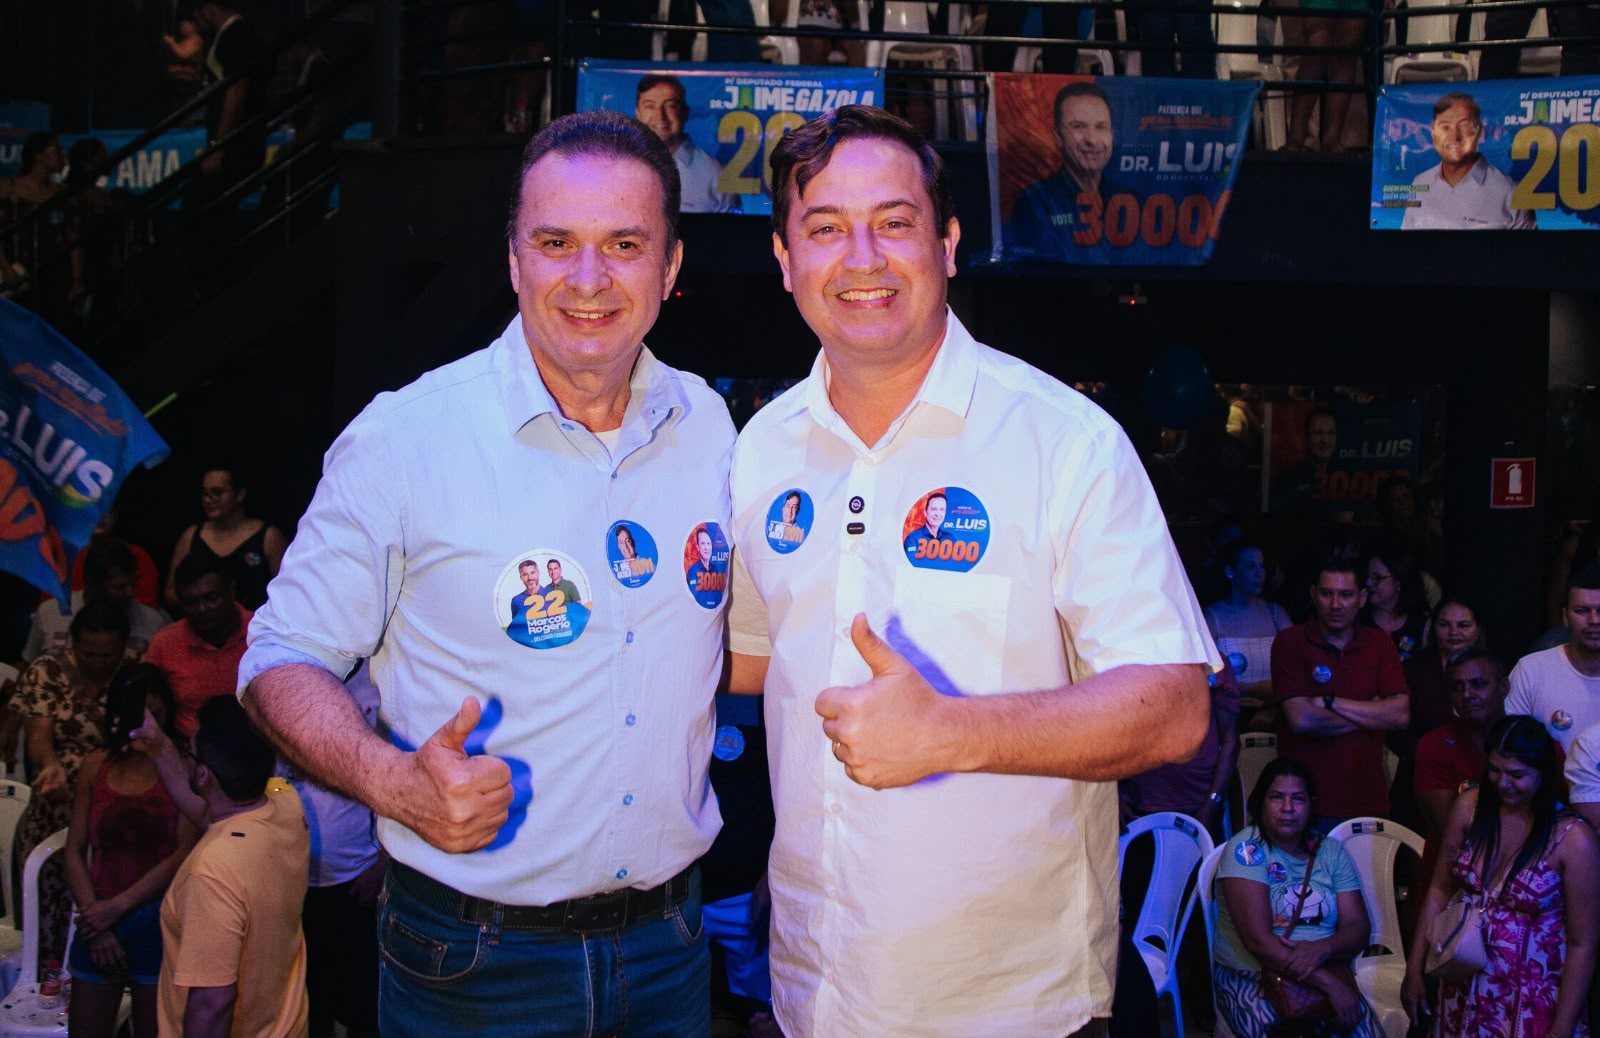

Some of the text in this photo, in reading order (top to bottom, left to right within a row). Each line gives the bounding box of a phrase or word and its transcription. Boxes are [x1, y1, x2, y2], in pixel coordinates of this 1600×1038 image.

[737, 78, 783, 87] DEPUTADO
[785, 79, 823, 88] FEDERAL
[1531, 90, 1580, 99] DEPUTADO
[1120, 155, 1154, 172] DR.
[1051, 213, 1074, 227] VOTE
[14, 404, 114, 501] LUIS
[1361, 437, 1414, 459] LUIS
[955, 517, 988, 530] LUIS
[914, 538, 980, 563] 30000
[523, 589, 568, 621] 22
[527, 614, 567, 628] Marcos
